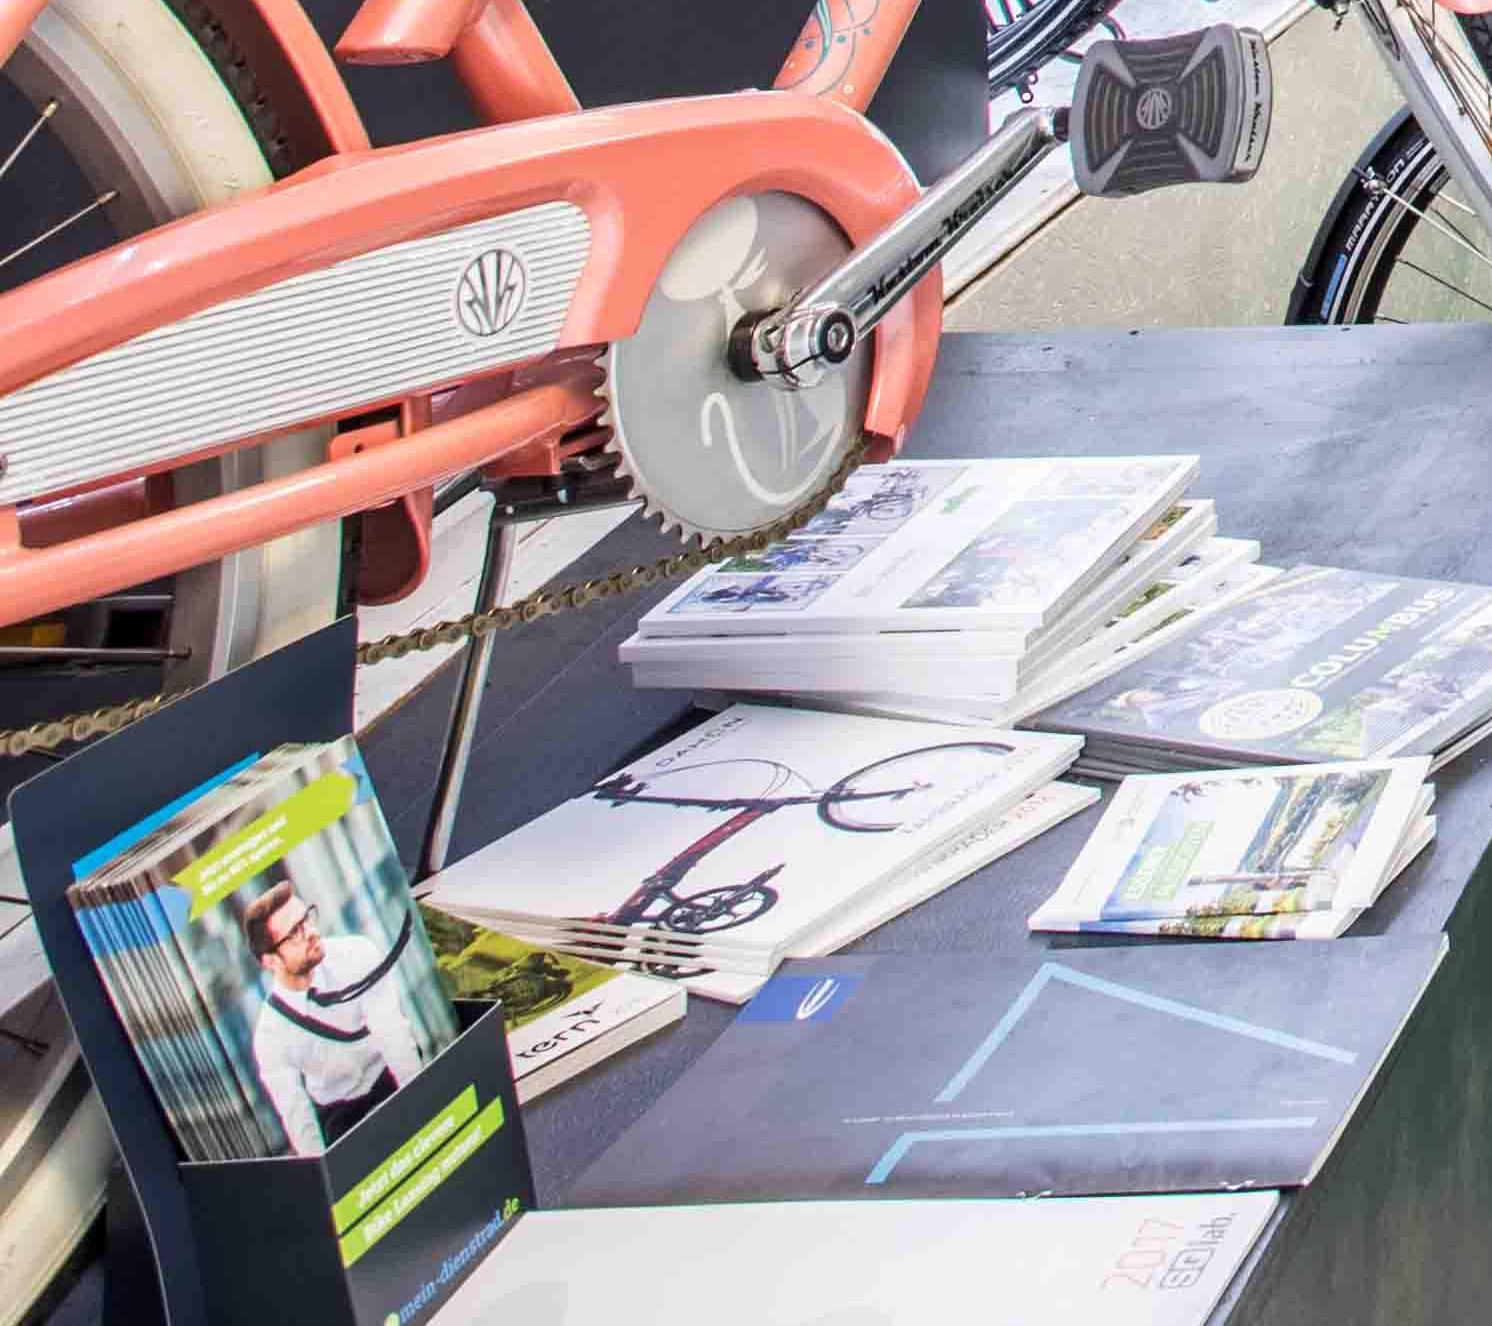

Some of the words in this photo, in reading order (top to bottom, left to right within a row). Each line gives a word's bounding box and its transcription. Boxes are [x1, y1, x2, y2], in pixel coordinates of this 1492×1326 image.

[1290, 588, 1456, 687] COLUMBUS
[514, 1018, 602, 1060] tern
[399, 1196, 521, 1324] mein-dienstrad.de
